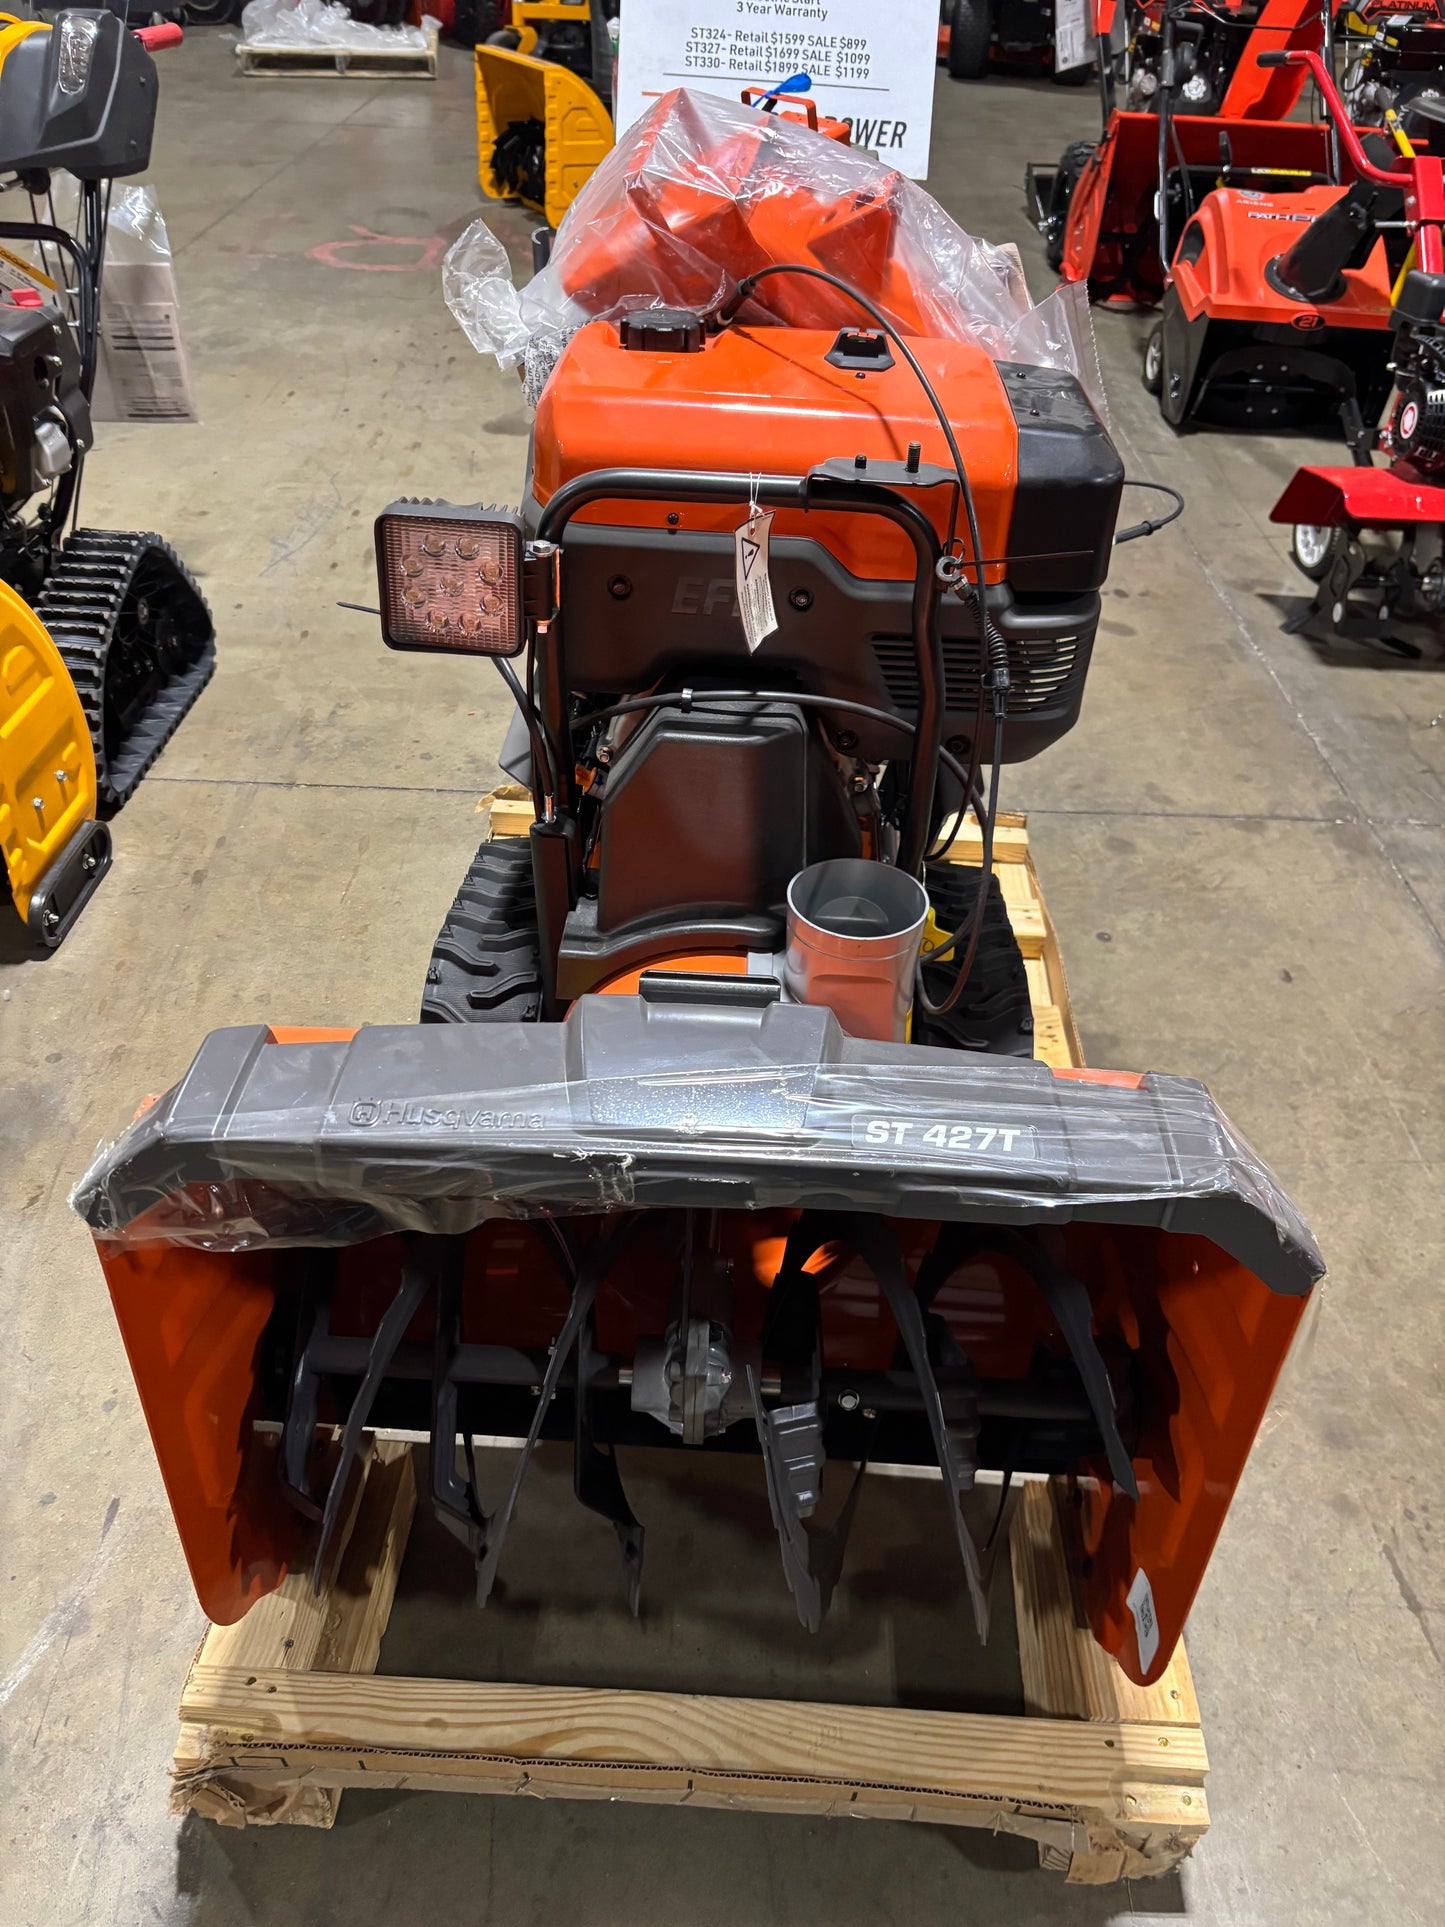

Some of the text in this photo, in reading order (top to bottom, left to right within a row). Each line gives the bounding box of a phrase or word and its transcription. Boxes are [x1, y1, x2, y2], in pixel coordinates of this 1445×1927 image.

[737, 2, 828, 21] 3 Year Warranty
[691, 27, 867, 50] ST324- Retail $1599 SALE $899
[685, 41, 870, 65] ST327- Retail $1699 SALE $1099
[685, 56, 870, 79] ST330- Retail $1899 SALE $1199
[825, 115, 907, 149] OWER
[384, 1101, 545, 1130] Husqvarna
[865, 1120, 1021, 1151] ST 427T
